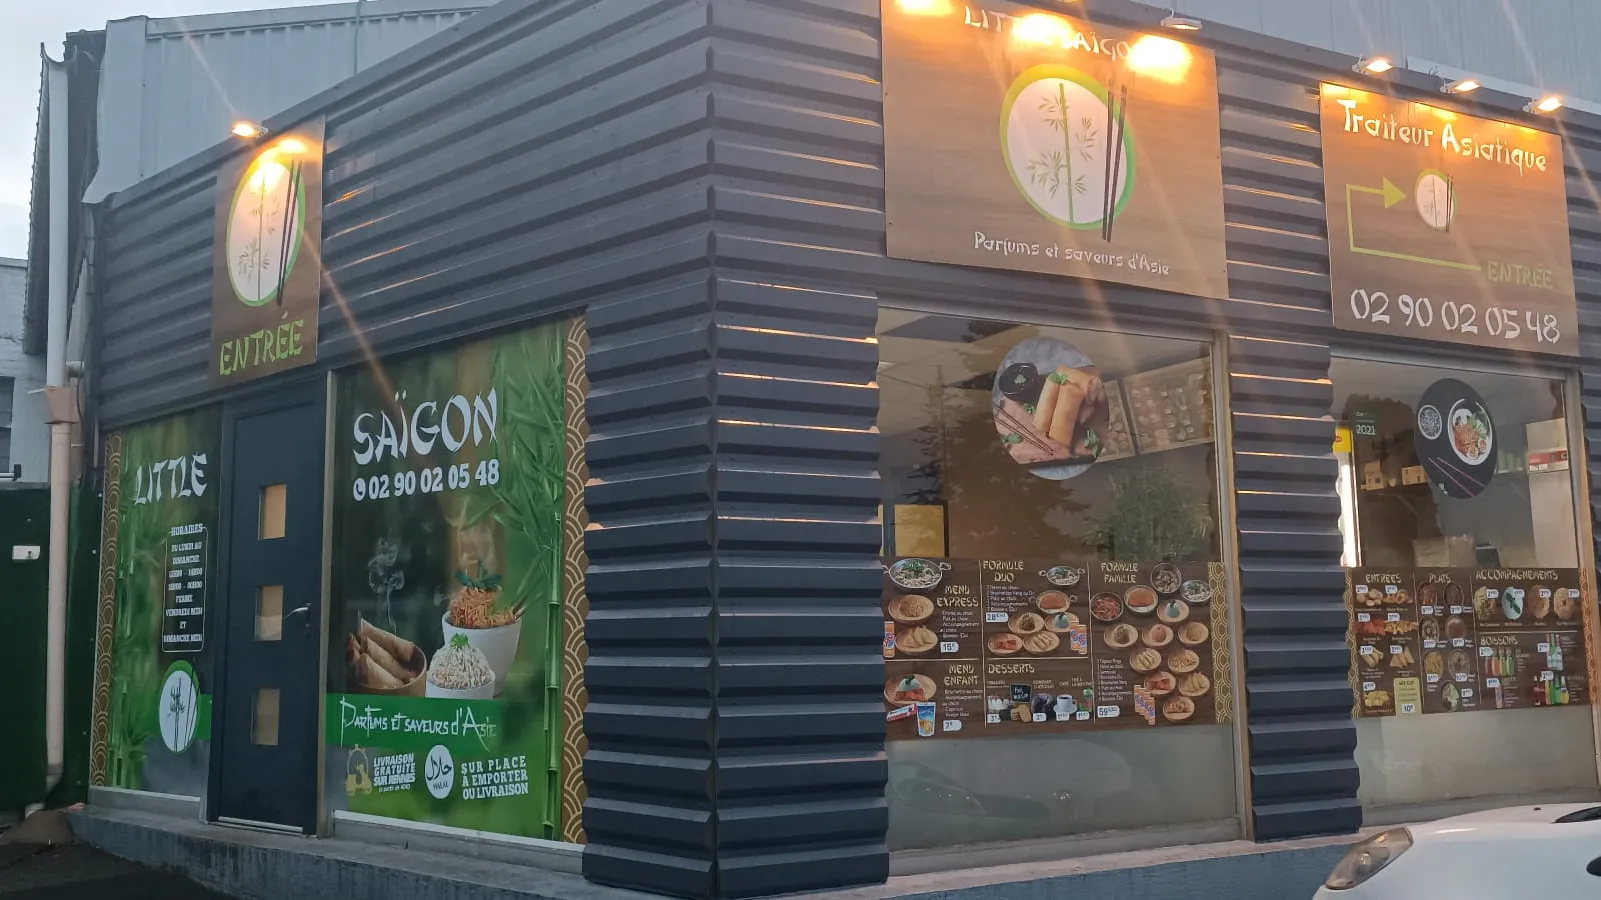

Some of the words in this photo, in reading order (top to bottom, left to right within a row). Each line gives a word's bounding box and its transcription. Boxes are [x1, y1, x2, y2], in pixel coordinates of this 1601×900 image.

[1337, 98, 1433, 147] Traiteur
[1441, 122, 1546, 177] Asiatique
[974, 231, 1040, 256] Parfums
[1045, 243, 1059, 258] et
[1064, 247, 1123, 267] saveurs
[1128, 253, 1170, 276] d'Asie
[1487, 260, 1553, 290] ENTRÉE
[1350, 289, 1390, 324] 02
[1398, 294, 1433, 328] 90
[1441, 301, 1478, 334] 02
[1485, 307, 1520, 339] 05
[1525, 311, 1560, 345] 48
[219, 310, 304, 376] ENTRÉE
[353, 386, 498, 466] SAÏGON
[1356, 424, 1376, 435] 2021
[133, 452, 208, 505] LITTLE
[368, 474, 390, 500] 02
[394, 471, 416, 497] 90
[420, 467, 443, 492] 02
[448, 463, 470, 490] 05
[475, 458, 500, 486] 48
[171, 523, 203, 536] HORAIRES
[983, 560, 1025, 570] FORMULE
[1101, 562, 1139, 573] FORMULE
[994, 572, 1015, 582] DUO
[1104, 574, 1138, 584] FAMILLE
[1428, 573, 1451, 584] PLATS
[1475, 569, 1559, 581] ACCOMPAGNEMENTS
[944, 585, 970, 595] MENU
[936, 597, 979, 607] EXPRESS
[1480, 635, 1518, 645] BOISSONS
[949, 664, 974, 674] MENU
[988, 664, 1035, 674] DESSERTS
[944, 674, 979, 686] ENFANT
[373, 752, 415, 768] LIVRAISON
[461, 761, 484, 775] SUR
[488, 755, 527, 773] PLACE
[374, 763, 416, 777] GRATUITE
[373, 775, 388, 786] SUR
[472, 769, 529, 787] EMPORTER
[462, 787, 476, 800] OU
[476, 782, 529, 799] LIVRAISON
